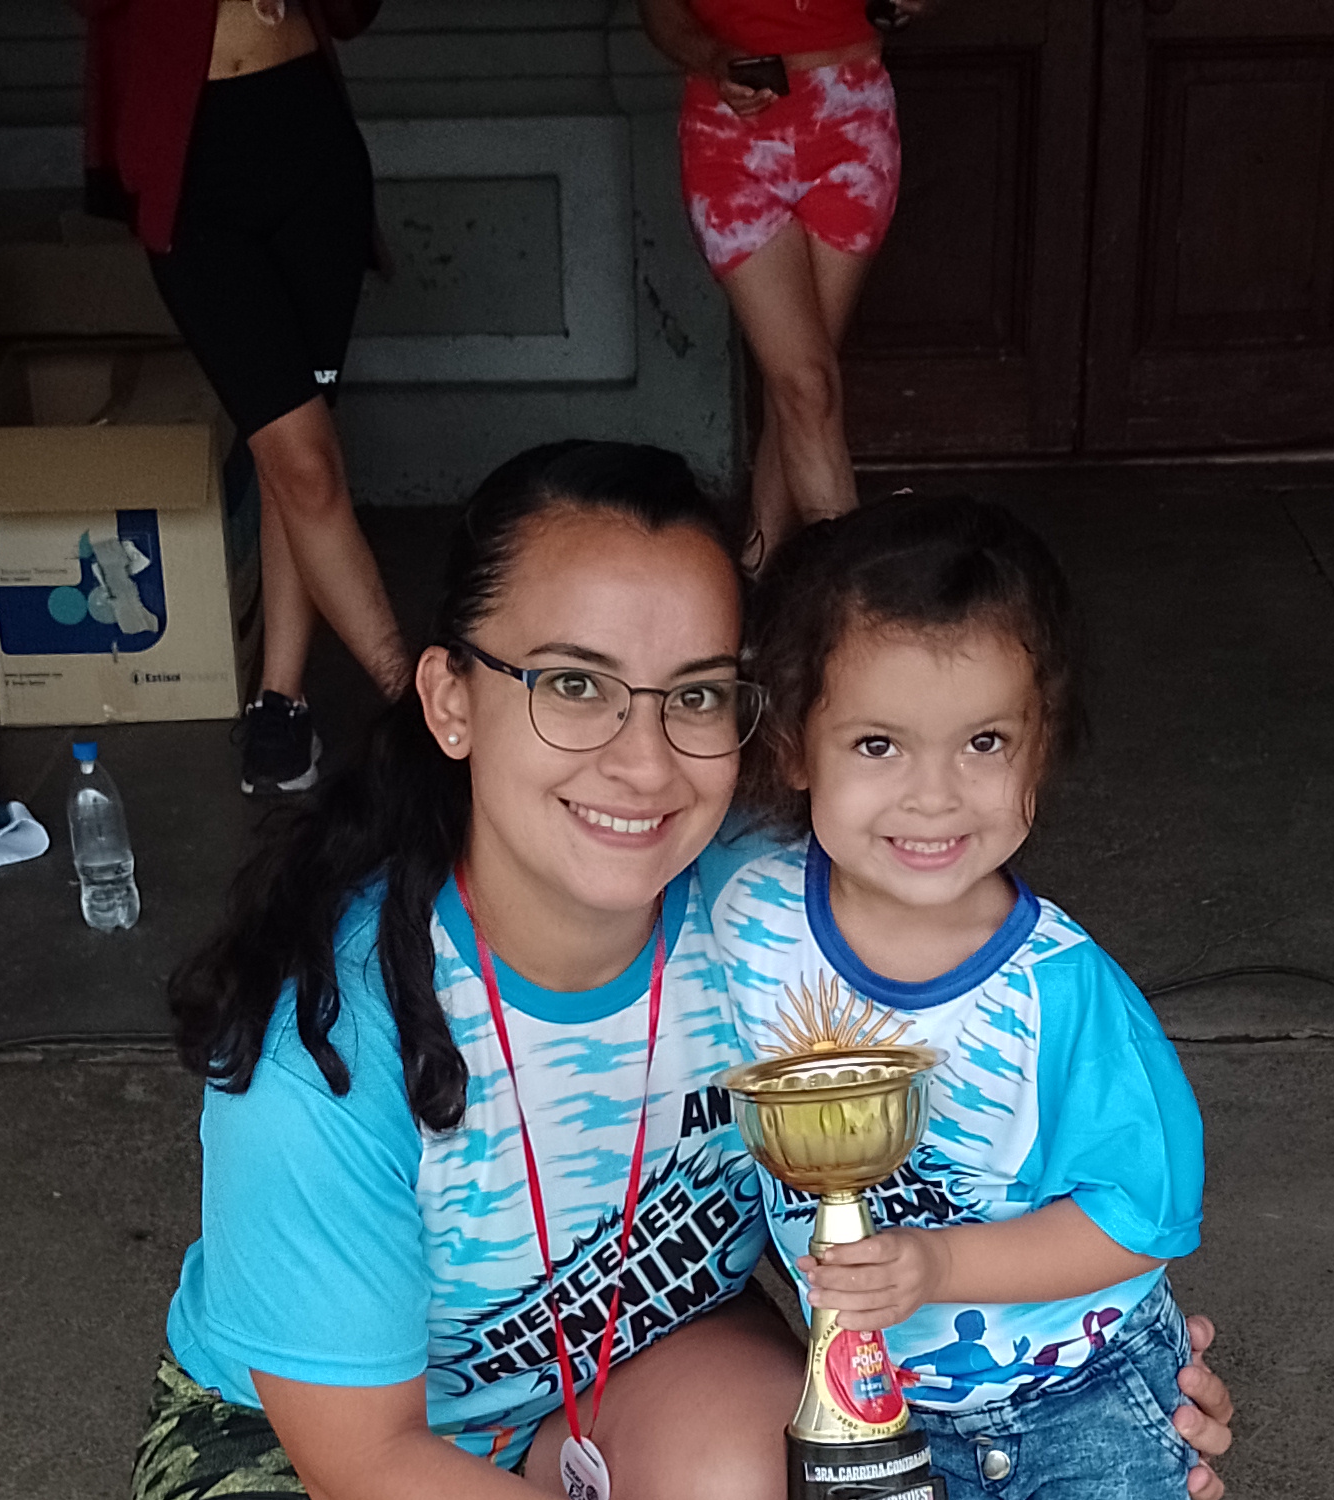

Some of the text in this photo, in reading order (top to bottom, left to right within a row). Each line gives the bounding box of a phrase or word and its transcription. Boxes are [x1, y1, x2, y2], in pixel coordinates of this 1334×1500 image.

[482, 1180, 694, 1351] MERCEDES
[471, 1188, 741, 1382] RUNNING
[855, 1342, 878, 1356] END
[851, 1350, 884, 1368] POLIO
[857, 1362, 883, 1377] NOW
[838, 1463, 885, 1482] CARRERA
